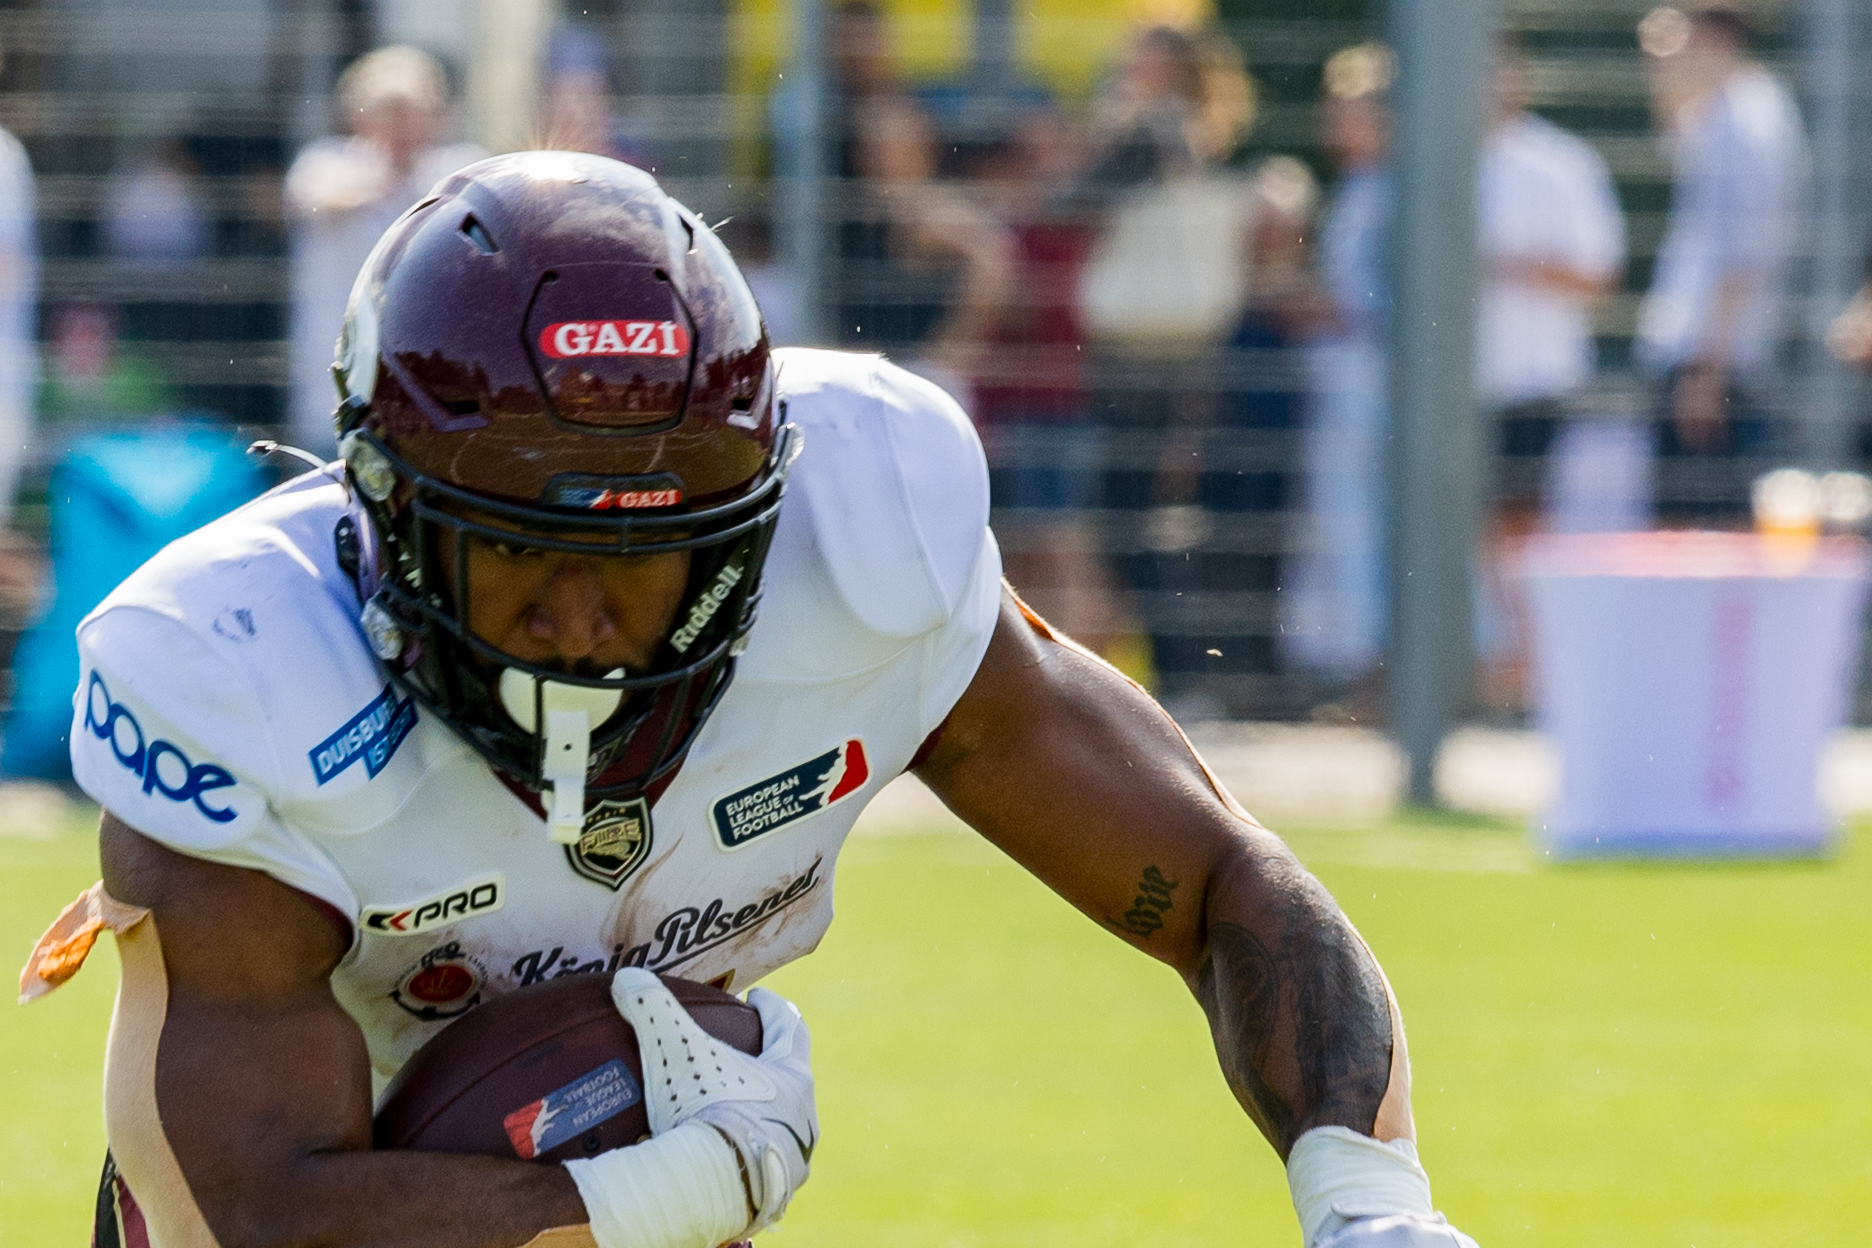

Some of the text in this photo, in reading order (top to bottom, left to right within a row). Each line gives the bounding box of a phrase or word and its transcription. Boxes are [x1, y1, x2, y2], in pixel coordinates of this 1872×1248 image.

[669, 565, 743, 653] Riddell
[84, 669, 239, 823] pape
[725, 774, 801, 817] EUROPEAN
[729, 796, 783, 829] LEAGUE
[732, 802, 804, 840] FOOTBALL
